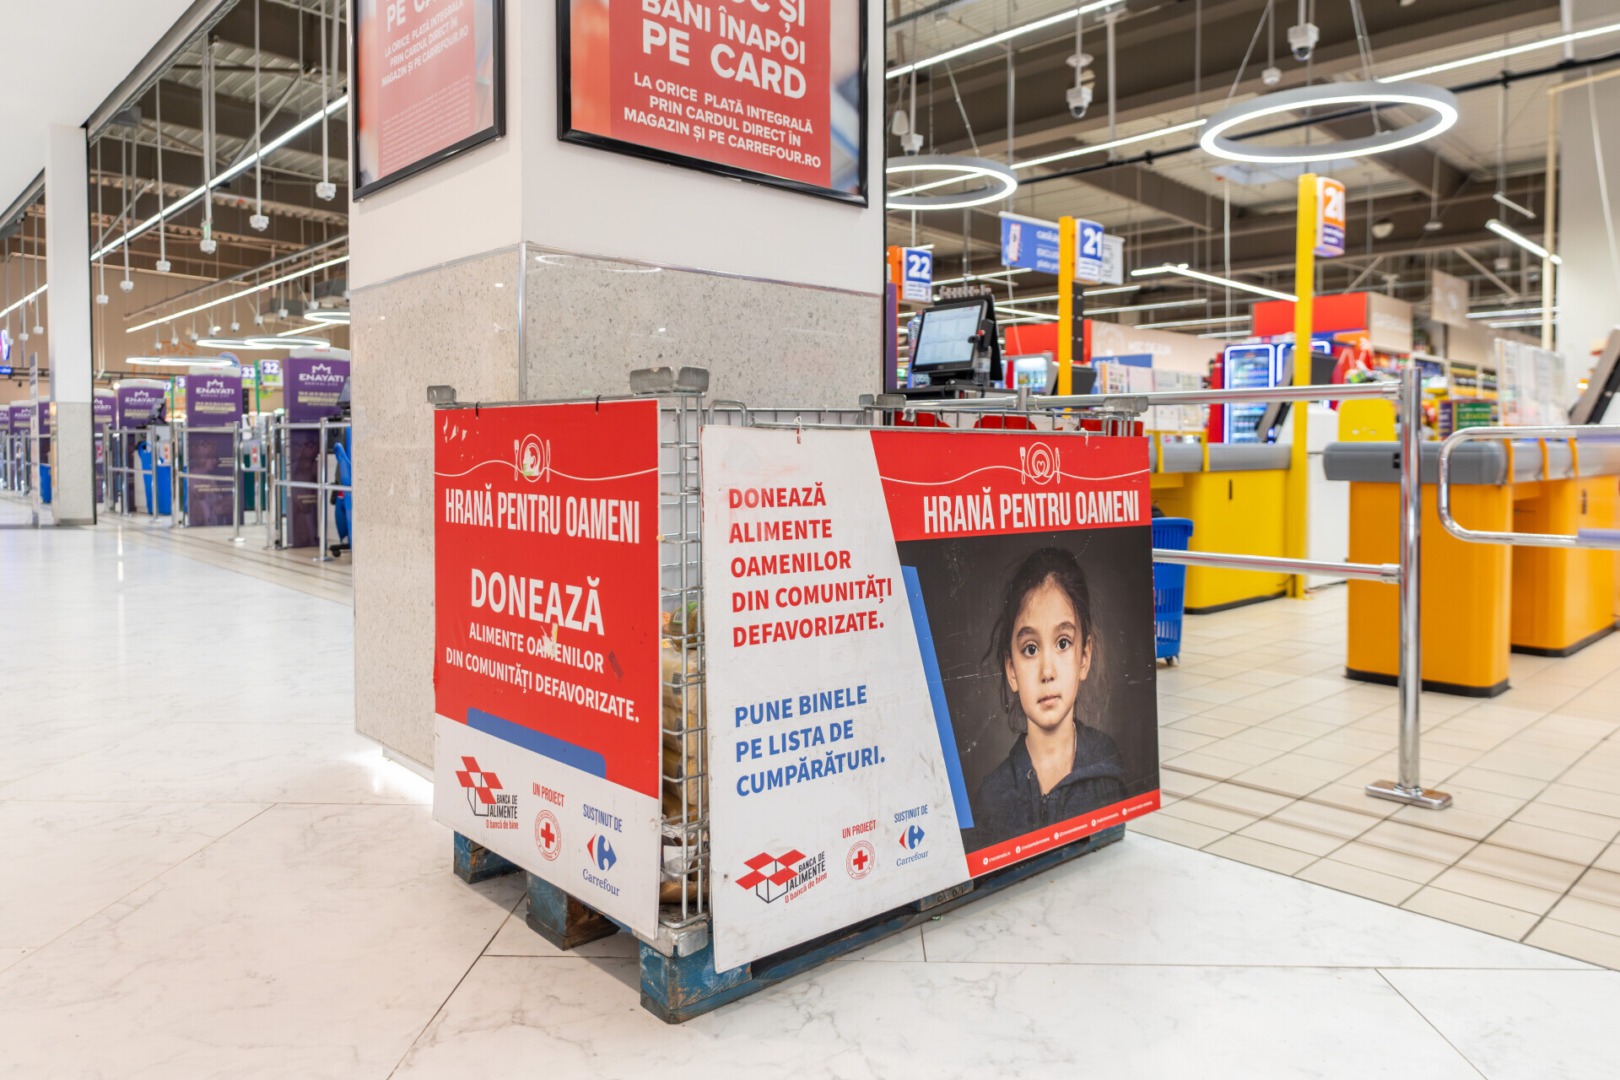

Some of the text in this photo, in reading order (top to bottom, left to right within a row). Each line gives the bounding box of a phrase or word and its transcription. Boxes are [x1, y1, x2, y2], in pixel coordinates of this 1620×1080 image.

[387, 0, 406, 33] PE
[641, 0, 806, 65] BANI ÎNAPOI
[643, 18, 807, 99] PE CARD
[634, 72, 813, 134] LA ORICE PLATĂ INTEGRALĂ
[650, 95, 801, 147] PRIN CARDUL DIRECT ÎN
[624, 107, 822, 168] MAGAZIN ȘI PE CARREFOUR.RO
[1083, 227, 1103, 258] 21
[908, 254, 931, 280] 22
[263, 361, 279, 374] 32
[299, 373, 344, 383] ENAYATI
[196, 387, 235, 395] ENAYATI
[729, 481, 827, 509] DONEAZĂ
[923, 486, 1140, 534] HRANĂ PENTRU OAMENI
[446, 483, 640, 544] HRANĂ PENTRU OAMENI
[729, 518, 833, 544] ALIMENTE
[730, 550, 852, 578] OAMENILOR
[471, 567, 605, 636] DONEAZĂ
[732, 574, 892, 613] DIN COMUNITĂȚI
[469, 622, 525, 653] ALIMENTE
[733, 610, 885, 648] DEFAVORIZATE.
[445, 646, 640, 724] DIN COMUNITĂȚI DEFAVORIZATE.
[735, 685, 868, 728] PUNE BINELE
[736, 719, 854, 763] PE LISTA DE
[736, 745, 886, 797] CUMPĂRĂTURI.
[496, 793, 518, 805] BANCA DE
[532, 782, 565, 808] UN PROIECT
[921, 804, 929, 816] DE
[489, 805, 518, 819] ALIMENTE
[613, 818, 623, 833] DE
[842, 819, 877, 839] UN PROIECT
[798, 850, 825, 873] BANCA DE
[896, 850, 929, 867] Carrefour
[582, 868, 620, 897] Carrefour
[789, 859, 826, 891] ALIMENTE
[807, 880, 815, 890] de
[815, 872, 828, 885] bine
